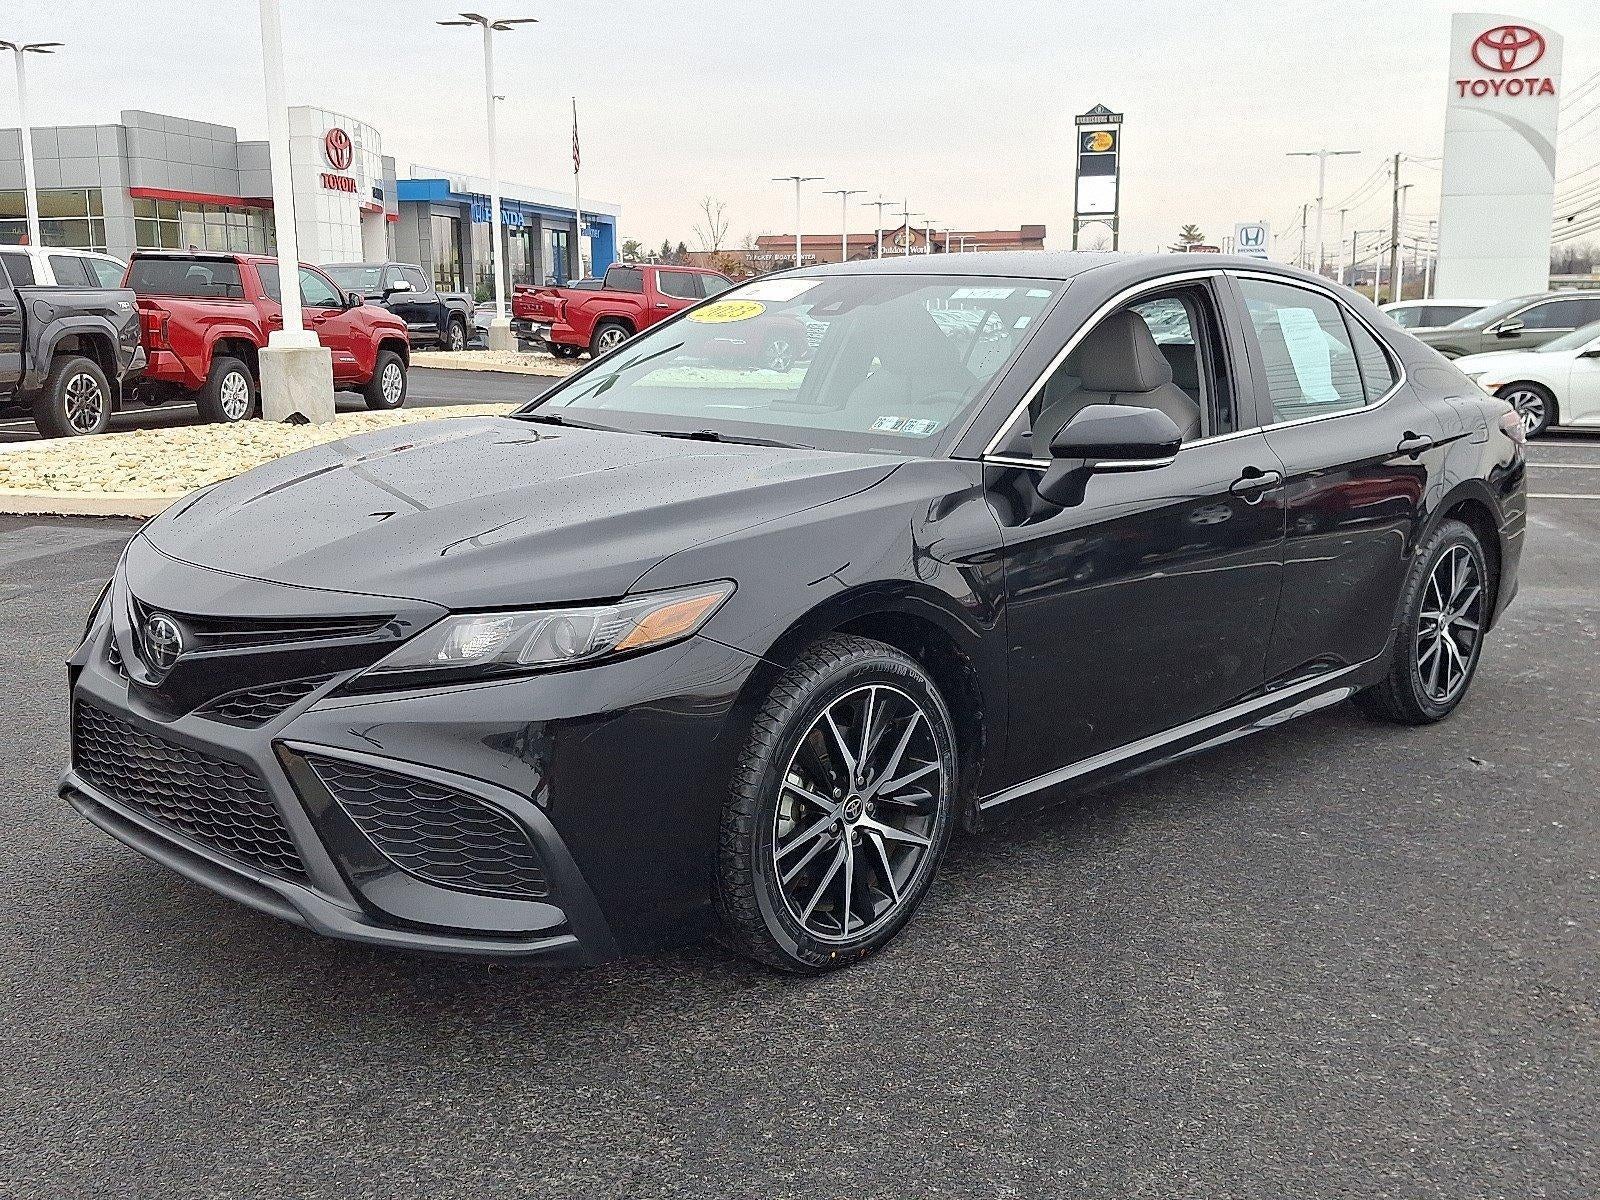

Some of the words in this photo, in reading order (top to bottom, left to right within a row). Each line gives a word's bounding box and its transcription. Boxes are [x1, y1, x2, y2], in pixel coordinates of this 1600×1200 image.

[1456, 78, 1555, 97] TOYOTA
[321, 173, 358, 193] TOYOTA
[484, 207, 525, 227] HNDA
